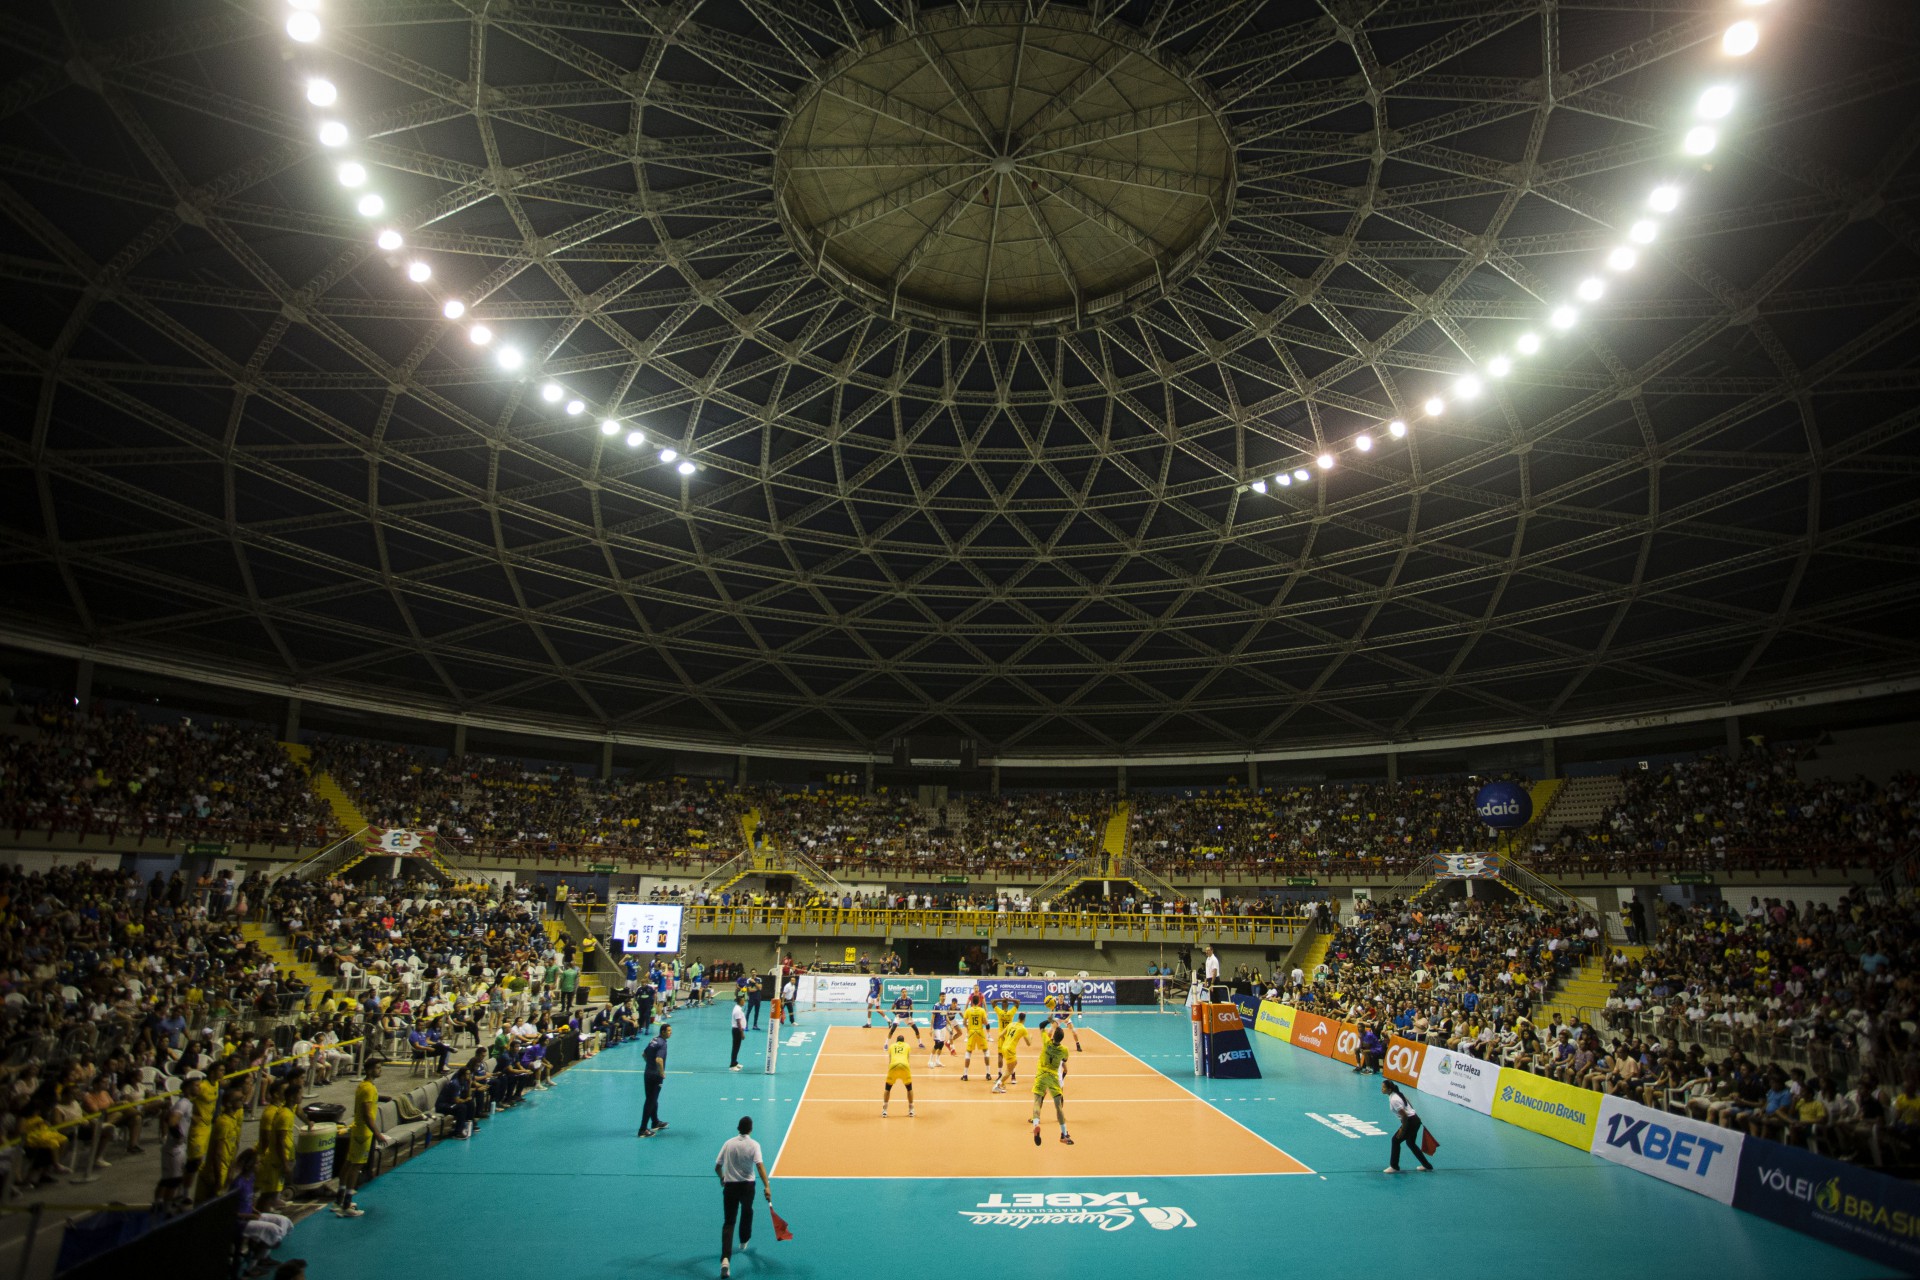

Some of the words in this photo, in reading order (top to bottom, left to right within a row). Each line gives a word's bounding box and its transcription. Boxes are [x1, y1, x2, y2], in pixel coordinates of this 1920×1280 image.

[643, 925, 654, 933] SET
[629, 933, 638, 943] 01
[645, 935, 650, 943] 2
[658, 933, 667, 943] 00
[944, 986, 974, 994] 1XBET
[972, 1016, 979, 1026] 15
[1218, 1012, 1238, 1021] GOL
[1007, 1028, 1016, 1038] 14
[1218, 1049, 1252, 1064] 1XBET
[1386, 1044, 1419, 1078] GOL
[1455, 1060, 1481, 1076] Fortaleza
[1514, 1090, 1543, 1111] BANCO
[1543, 1101, 1556, 1115] DO
[1556, 1103, 1586, 1125] BRASIL
[1606, 1112, 1724, 1177] 1XBET
[1758, 1165, 1814, 1202] VÔLEI
[976, 1191, 1149, 1208] 1XBET
[958, 1207, 1135, 1232] Superliga
